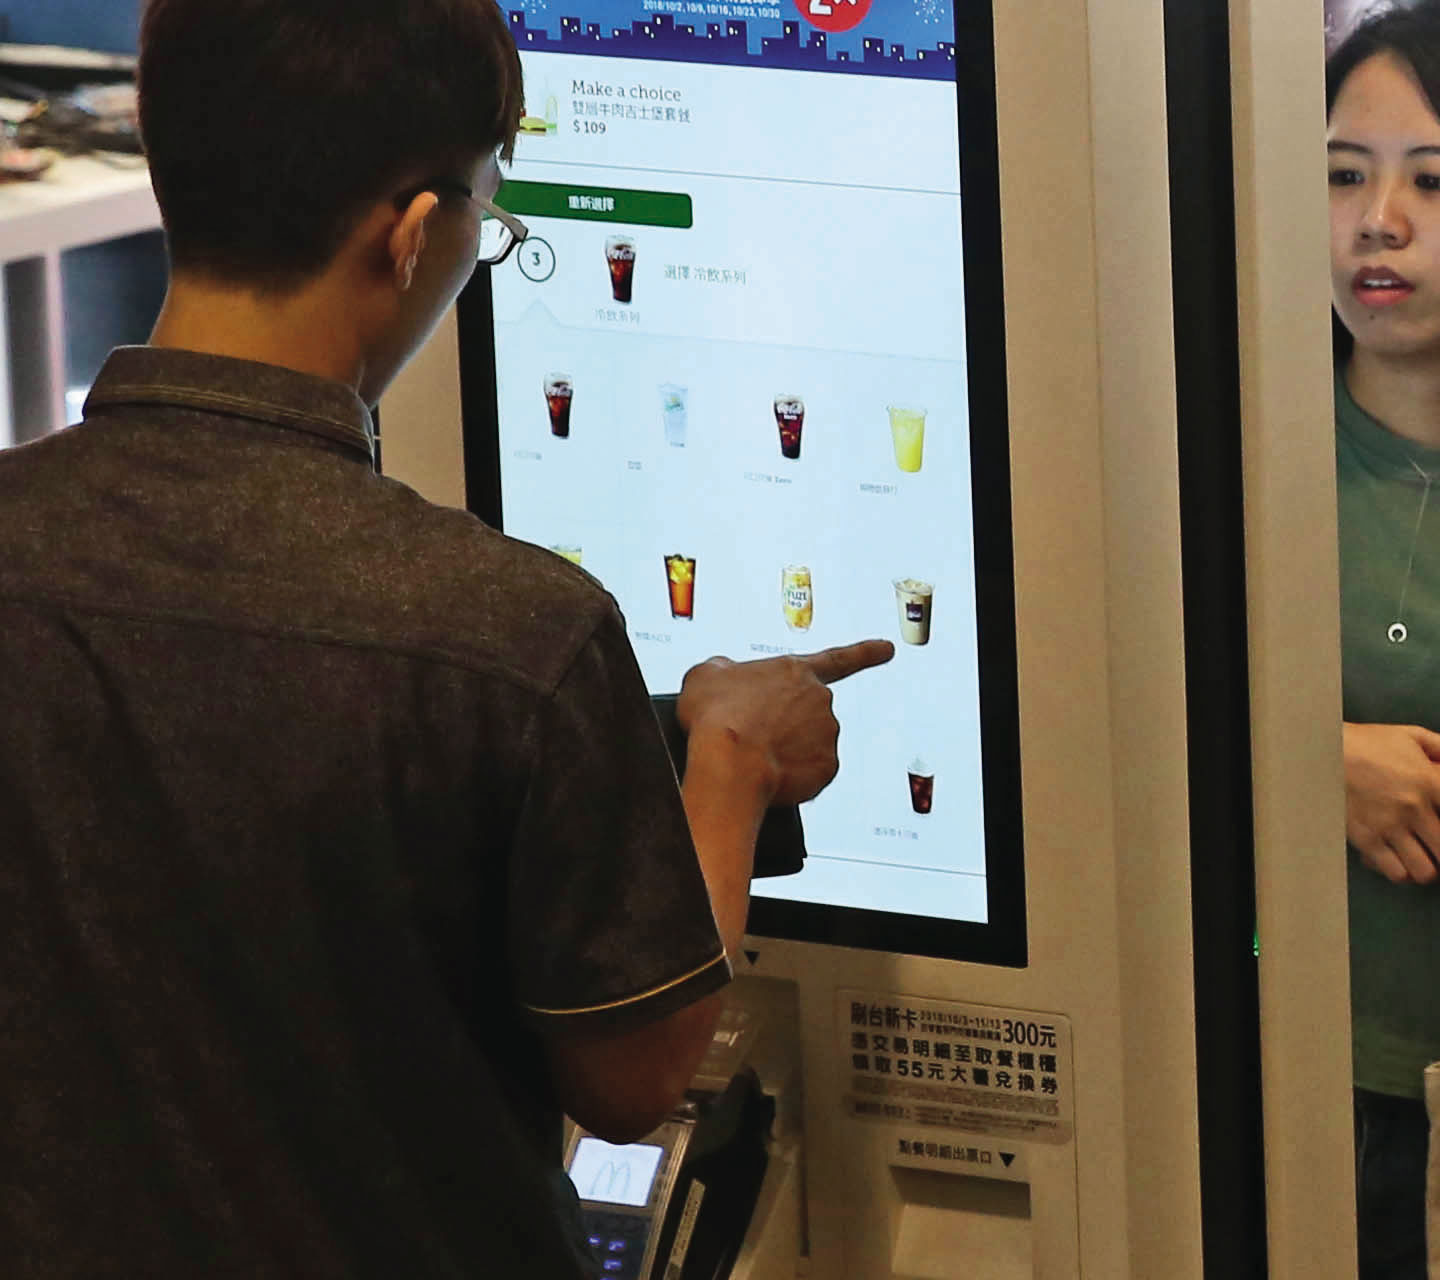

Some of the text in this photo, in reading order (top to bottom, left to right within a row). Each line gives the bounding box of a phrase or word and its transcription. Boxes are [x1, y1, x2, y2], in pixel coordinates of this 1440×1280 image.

[572, 80, 682, 103] Make a choice
[531, 252, 541, 266] 3
[1003, 1019, 1057, 1049] 300元
